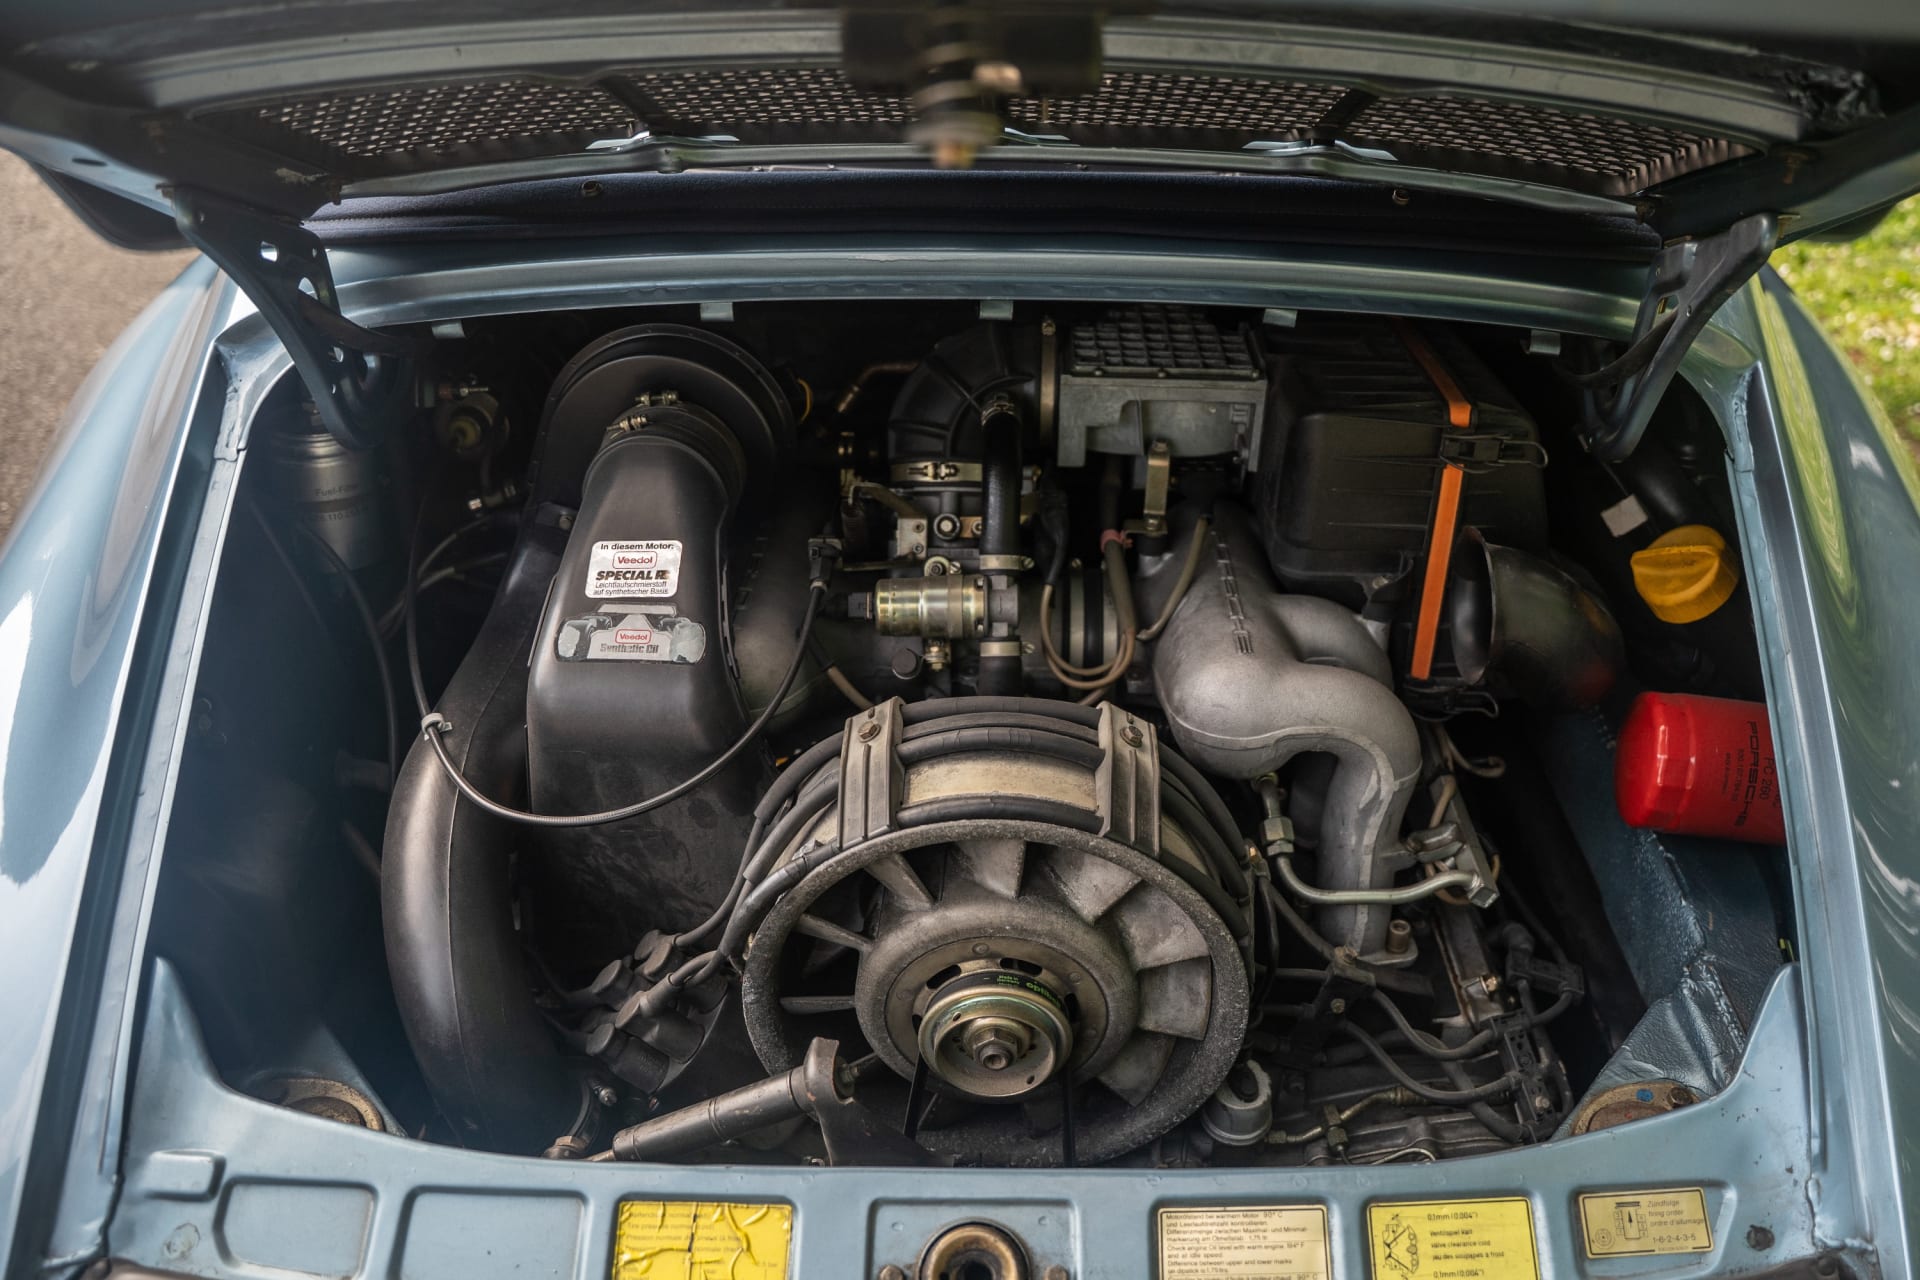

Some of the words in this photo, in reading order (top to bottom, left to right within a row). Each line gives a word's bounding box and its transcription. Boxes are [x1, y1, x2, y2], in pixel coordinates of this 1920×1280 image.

[617, 556, 653, 564] Veedol
[595, 570, 653, 581] SPECIAL
[620, 633, 648, 641] Veedol
[1734, 720, 1760, 826] PORSCHE
